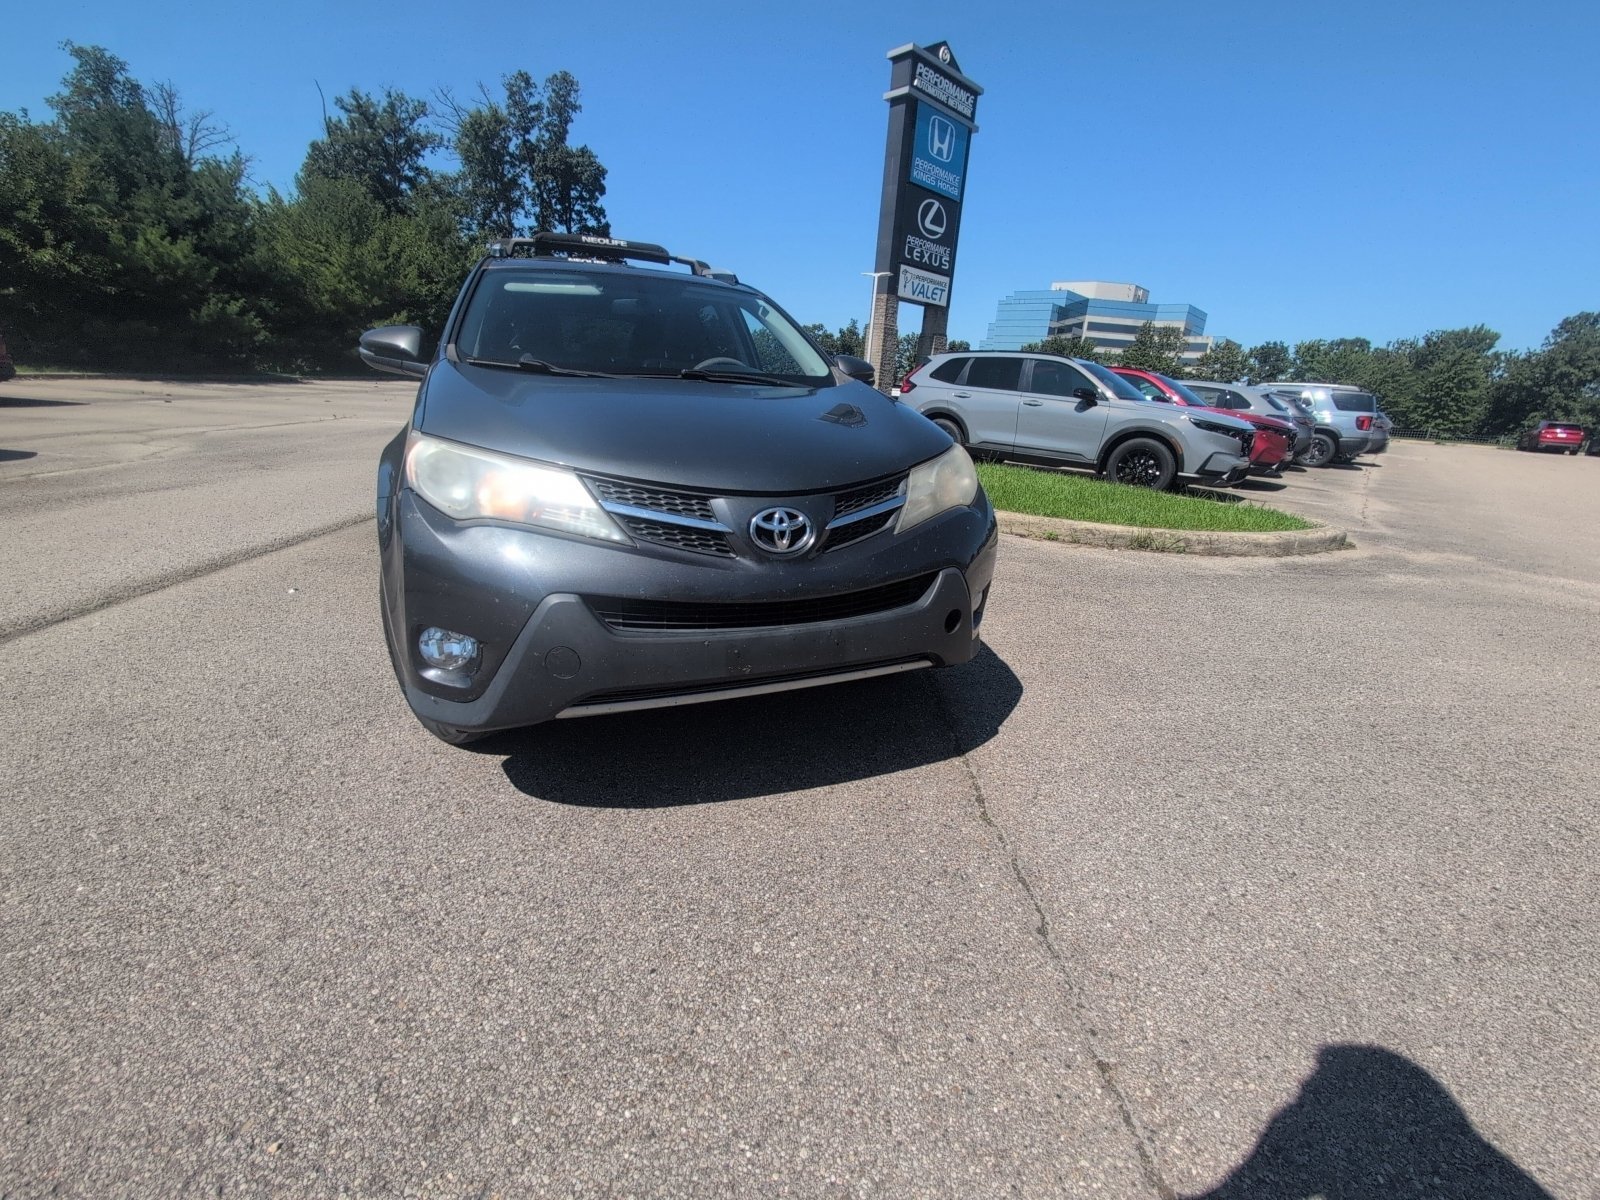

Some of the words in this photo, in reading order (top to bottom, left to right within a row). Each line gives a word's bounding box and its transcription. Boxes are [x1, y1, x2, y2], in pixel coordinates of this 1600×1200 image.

[913, 78, 949, 104] AUTOMOTIVE
[915, 62, 974, 108] PERFORMANCE
[913, 168, 936, 186] KINGS
[914, 157, 960, 186] PERFORMANCE
[581, 236, 628, 247] NEOLIFE
[906, 234, 950, 257] PERFORMANCE
[904, 244, 950, 269] LEXUS
[911, 280, 946, 302] VALET
[915, 274, 948, 289] PERFORMANCE
